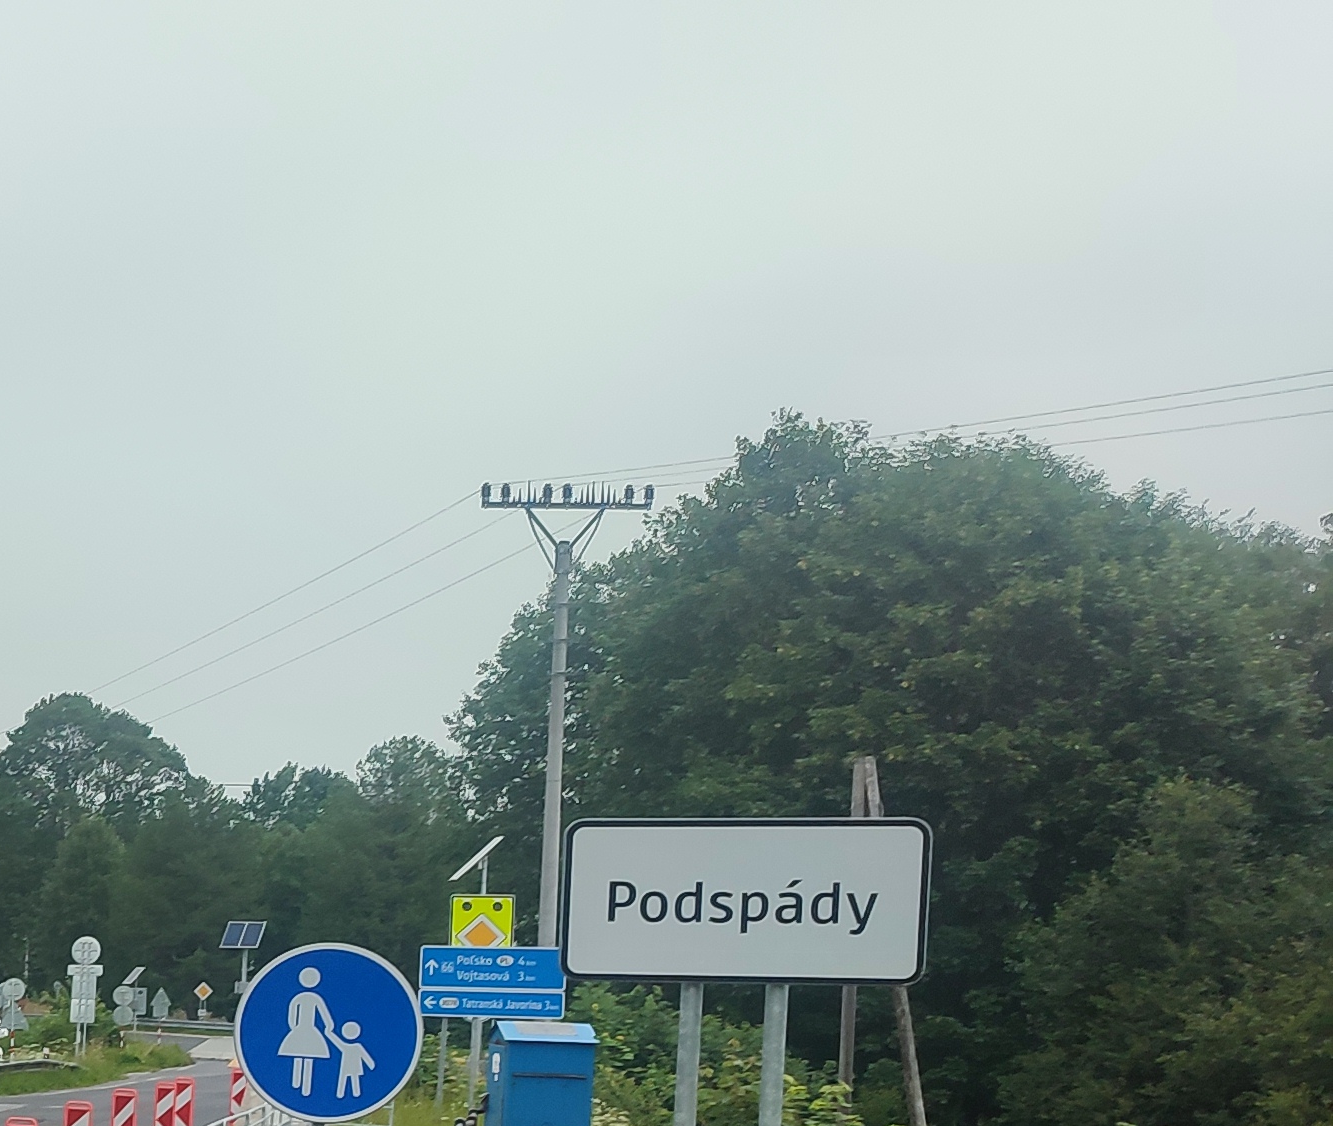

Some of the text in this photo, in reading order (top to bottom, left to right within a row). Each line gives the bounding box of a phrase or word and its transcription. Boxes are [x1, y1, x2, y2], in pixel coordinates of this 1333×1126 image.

[606, 879, 879, 936] Podspády
[441, 961, 454, 973] 66
[456, 955, 493, 967] Poľsko
[517, 956, 525, 967] 4
[456, 970, 510, 982] Vojtasová
[517, 971, 525, 982] 3
[544, 1000, 551, 1011] 3
